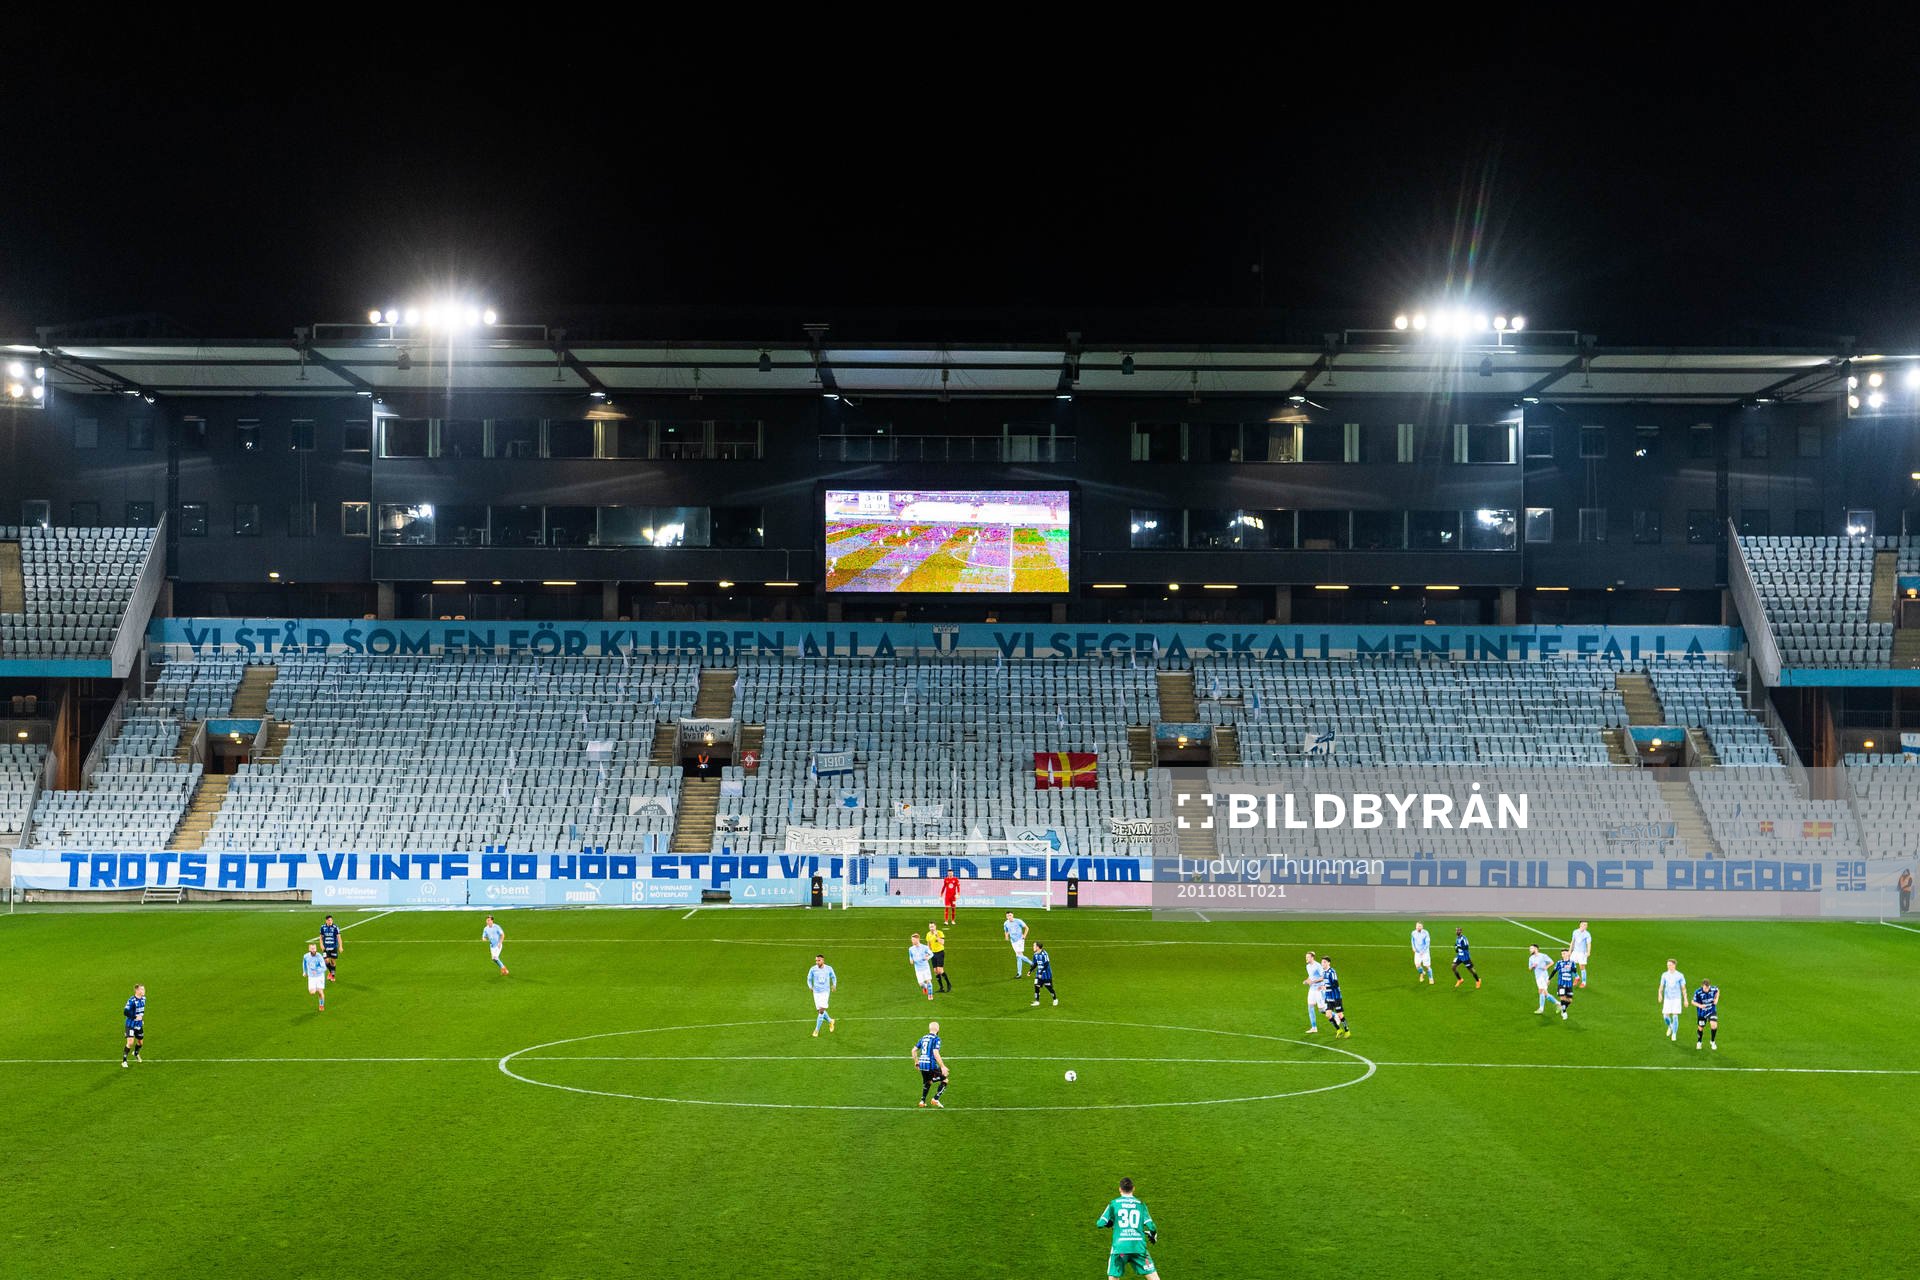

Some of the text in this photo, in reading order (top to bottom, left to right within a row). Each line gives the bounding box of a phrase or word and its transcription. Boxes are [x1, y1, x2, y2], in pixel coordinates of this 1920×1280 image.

[184, 627, 220, 654] VI
[235, 621, 331, 655] STÅR
[344, 628, 430, 655] SOM
[509, 620, 587, 657] FÖR
[993, 632, 1034, 658] VI
[60, 852, 208, 888] TROTS
[217, 853, 307, 889] ATT
[317, 853, 358, 880] VI
[1117, 1209, 1140, 1228] 30
